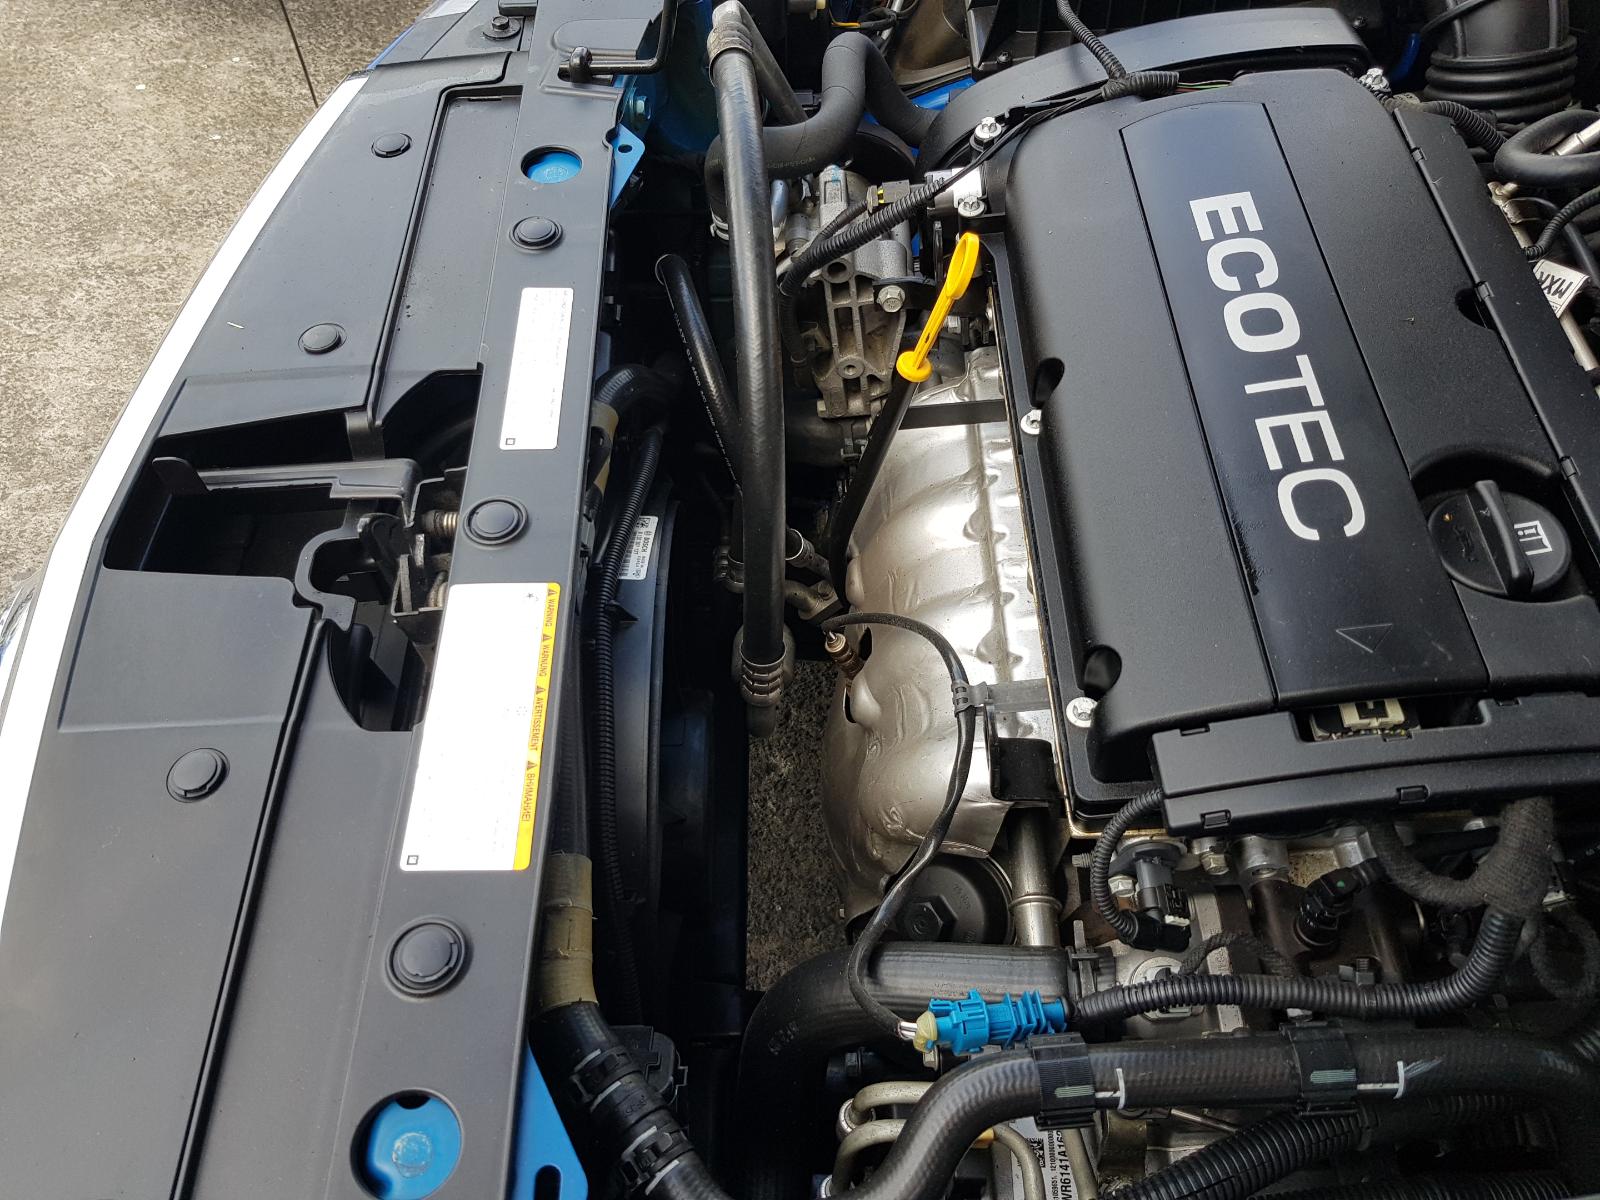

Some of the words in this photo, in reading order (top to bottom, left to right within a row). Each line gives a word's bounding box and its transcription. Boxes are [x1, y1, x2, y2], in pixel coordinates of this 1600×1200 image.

[1189, 191, 1366, 541] ECOTEC
[641, 537, 651, 553] BOSCH
[545, 599, 555, 627] WARNING
[539, 644, 550, 677] WARNUNG
[530, 697, 544, 751] AVERTISSEMENT
